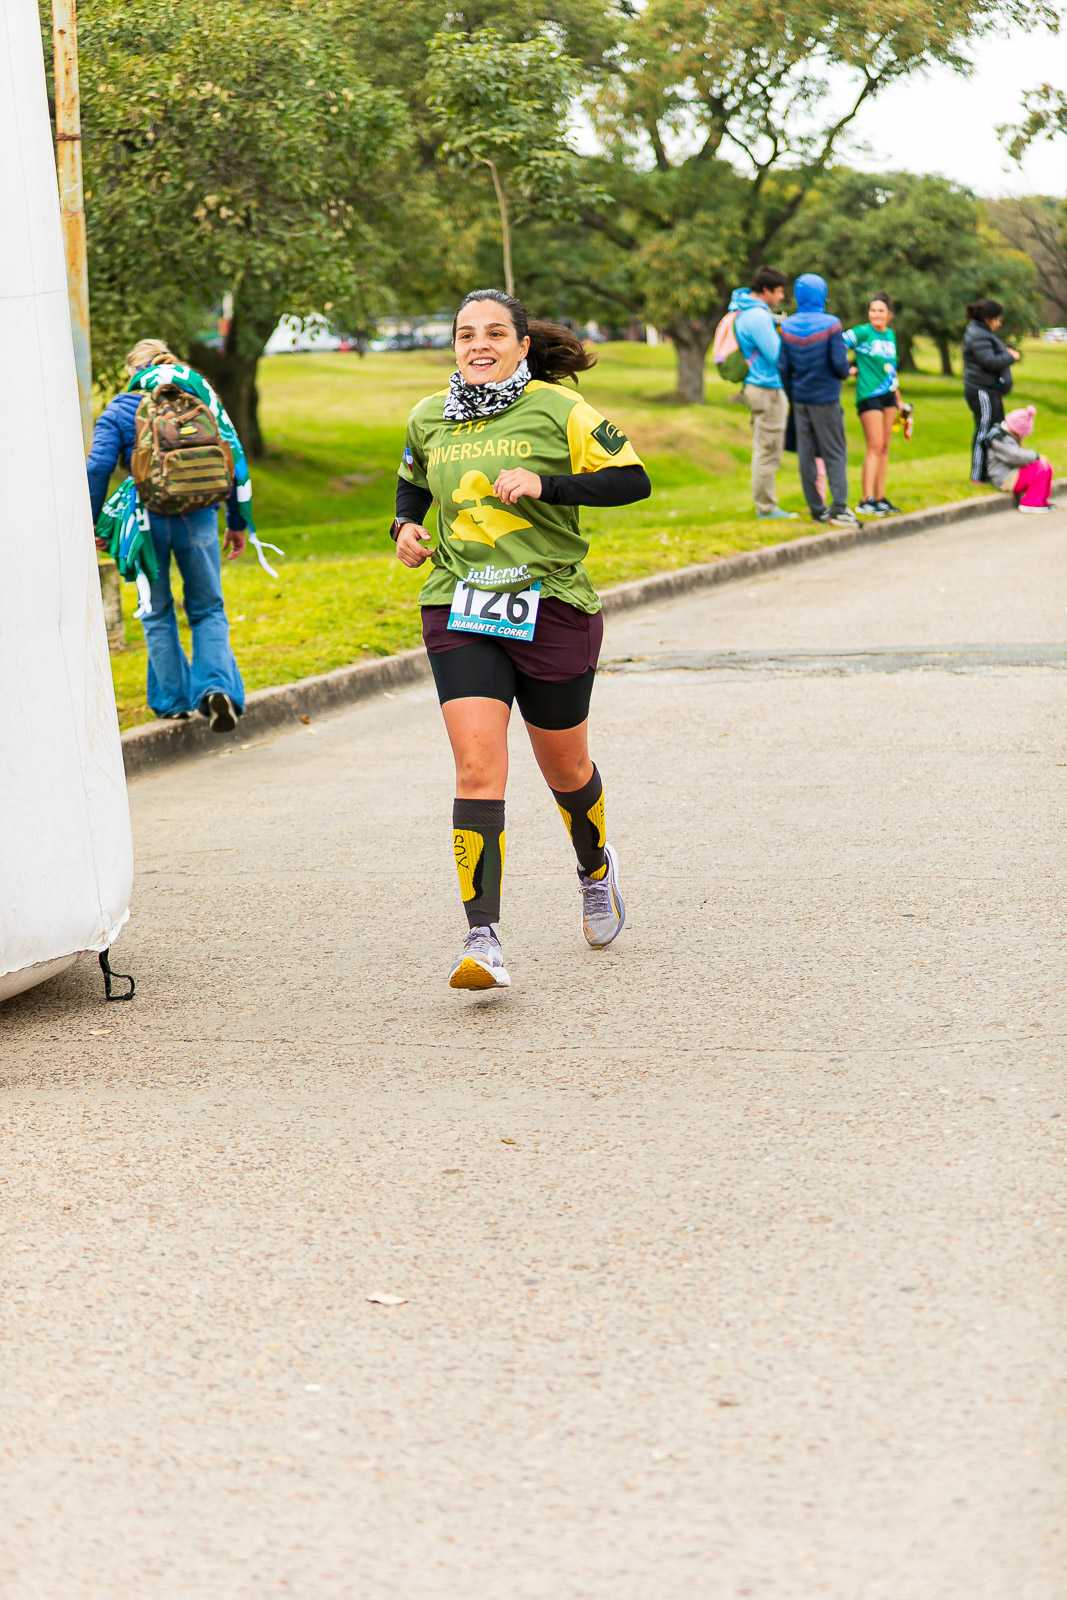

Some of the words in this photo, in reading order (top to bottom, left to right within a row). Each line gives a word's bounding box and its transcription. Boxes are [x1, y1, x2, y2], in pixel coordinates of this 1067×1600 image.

[427, 439, 532, 468] NIVERSARIO
[463, 564, 528, 582] julicroc
[463, 583, 531, 624] 126
[451, 620, 497, 634] DIAMANTE
[497, 626, 529, 638] CORRE
